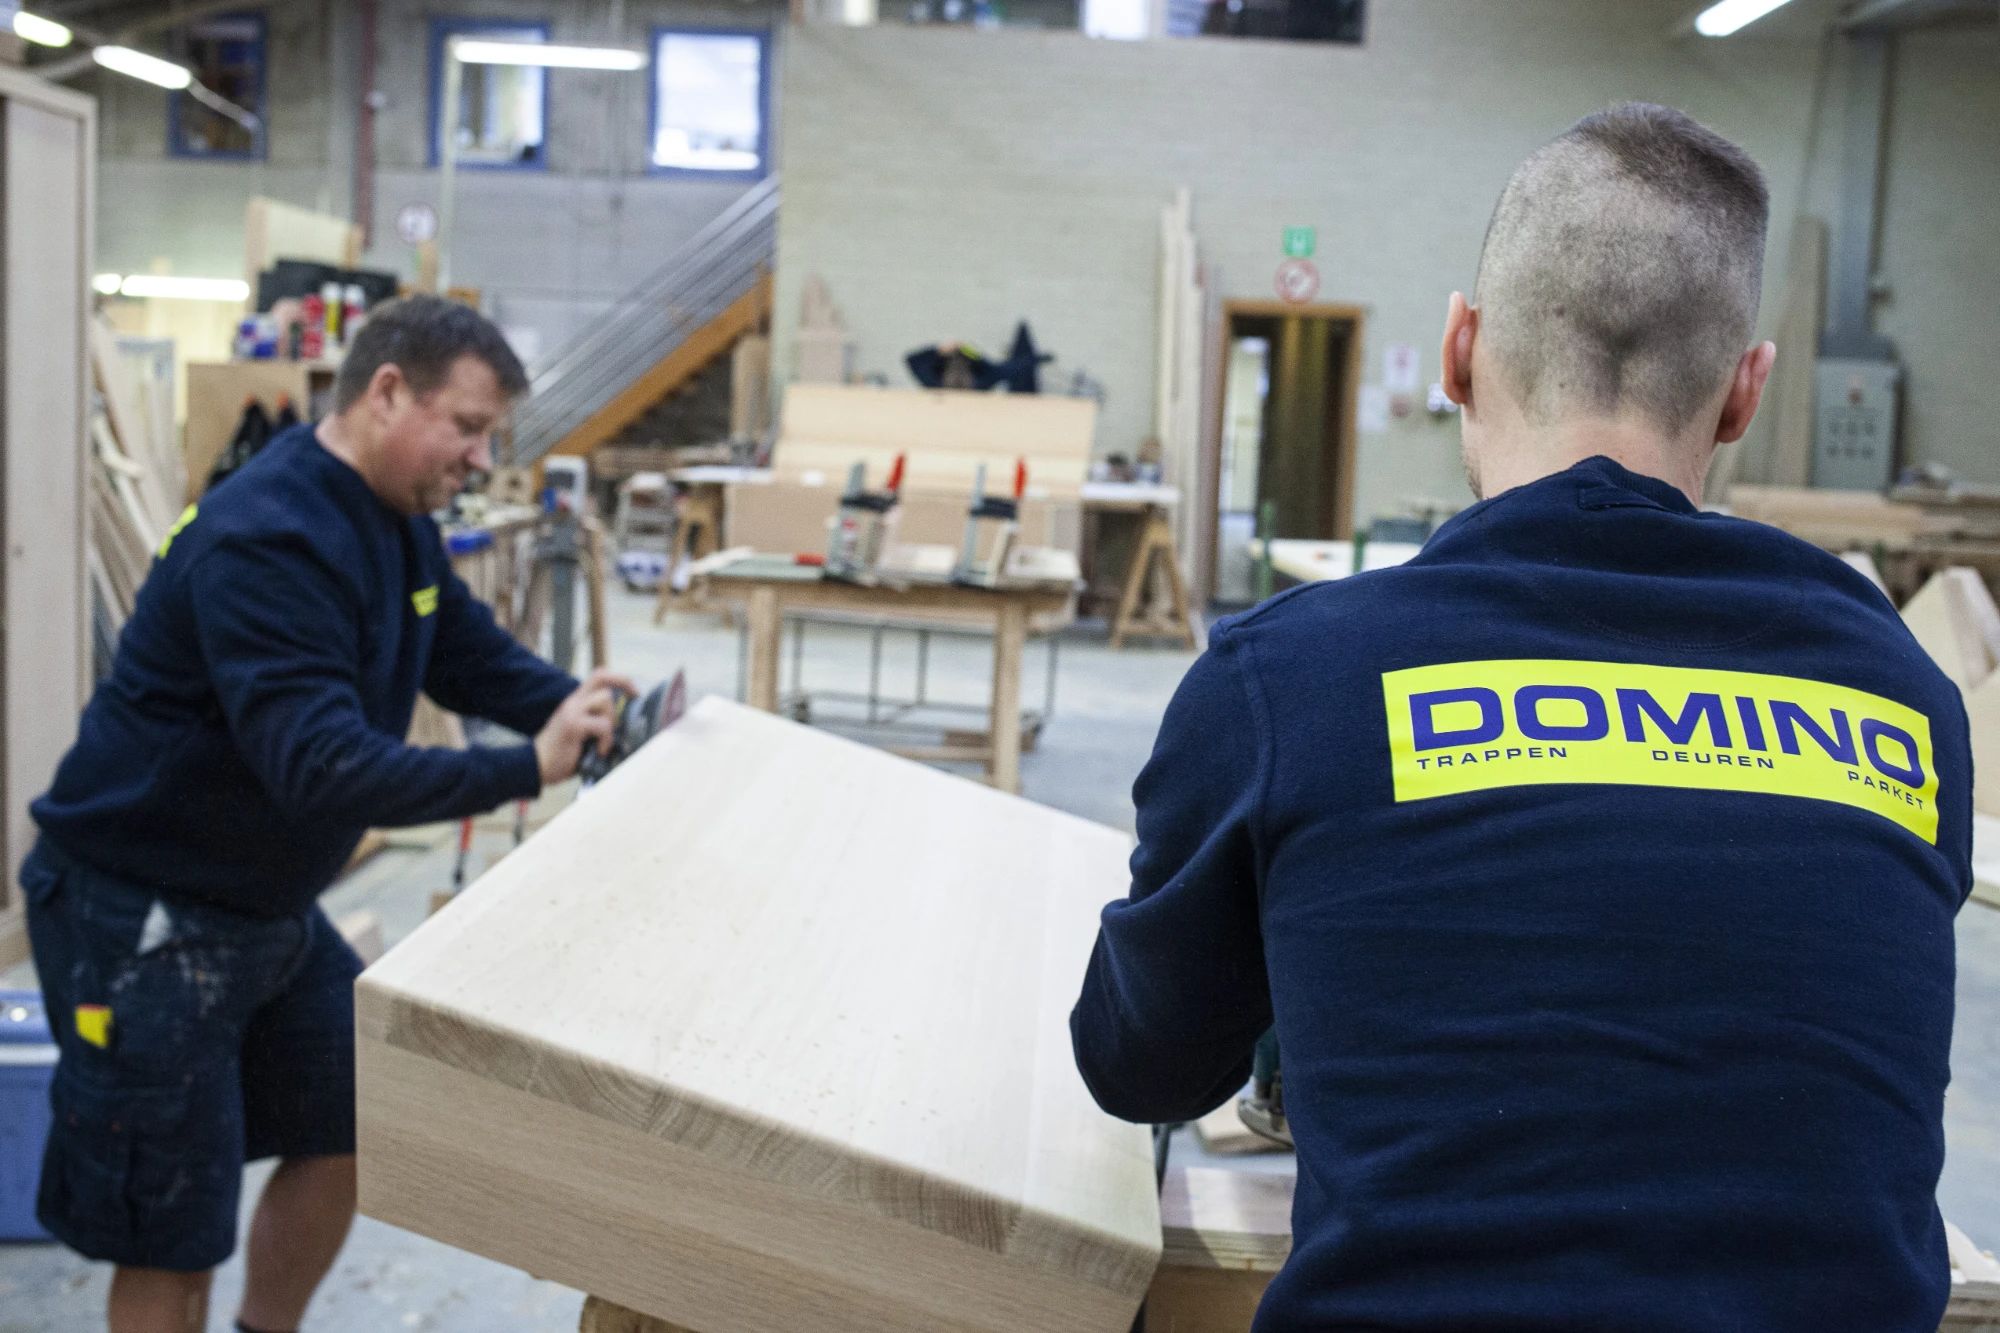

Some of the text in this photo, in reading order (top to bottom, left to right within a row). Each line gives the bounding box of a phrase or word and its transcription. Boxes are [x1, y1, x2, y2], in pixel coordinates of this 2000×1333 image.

[1408, 685, 1925, 789] DOMINO
[1416, 747, 1923, 810] TRAPPEN DEUREN PARKET
